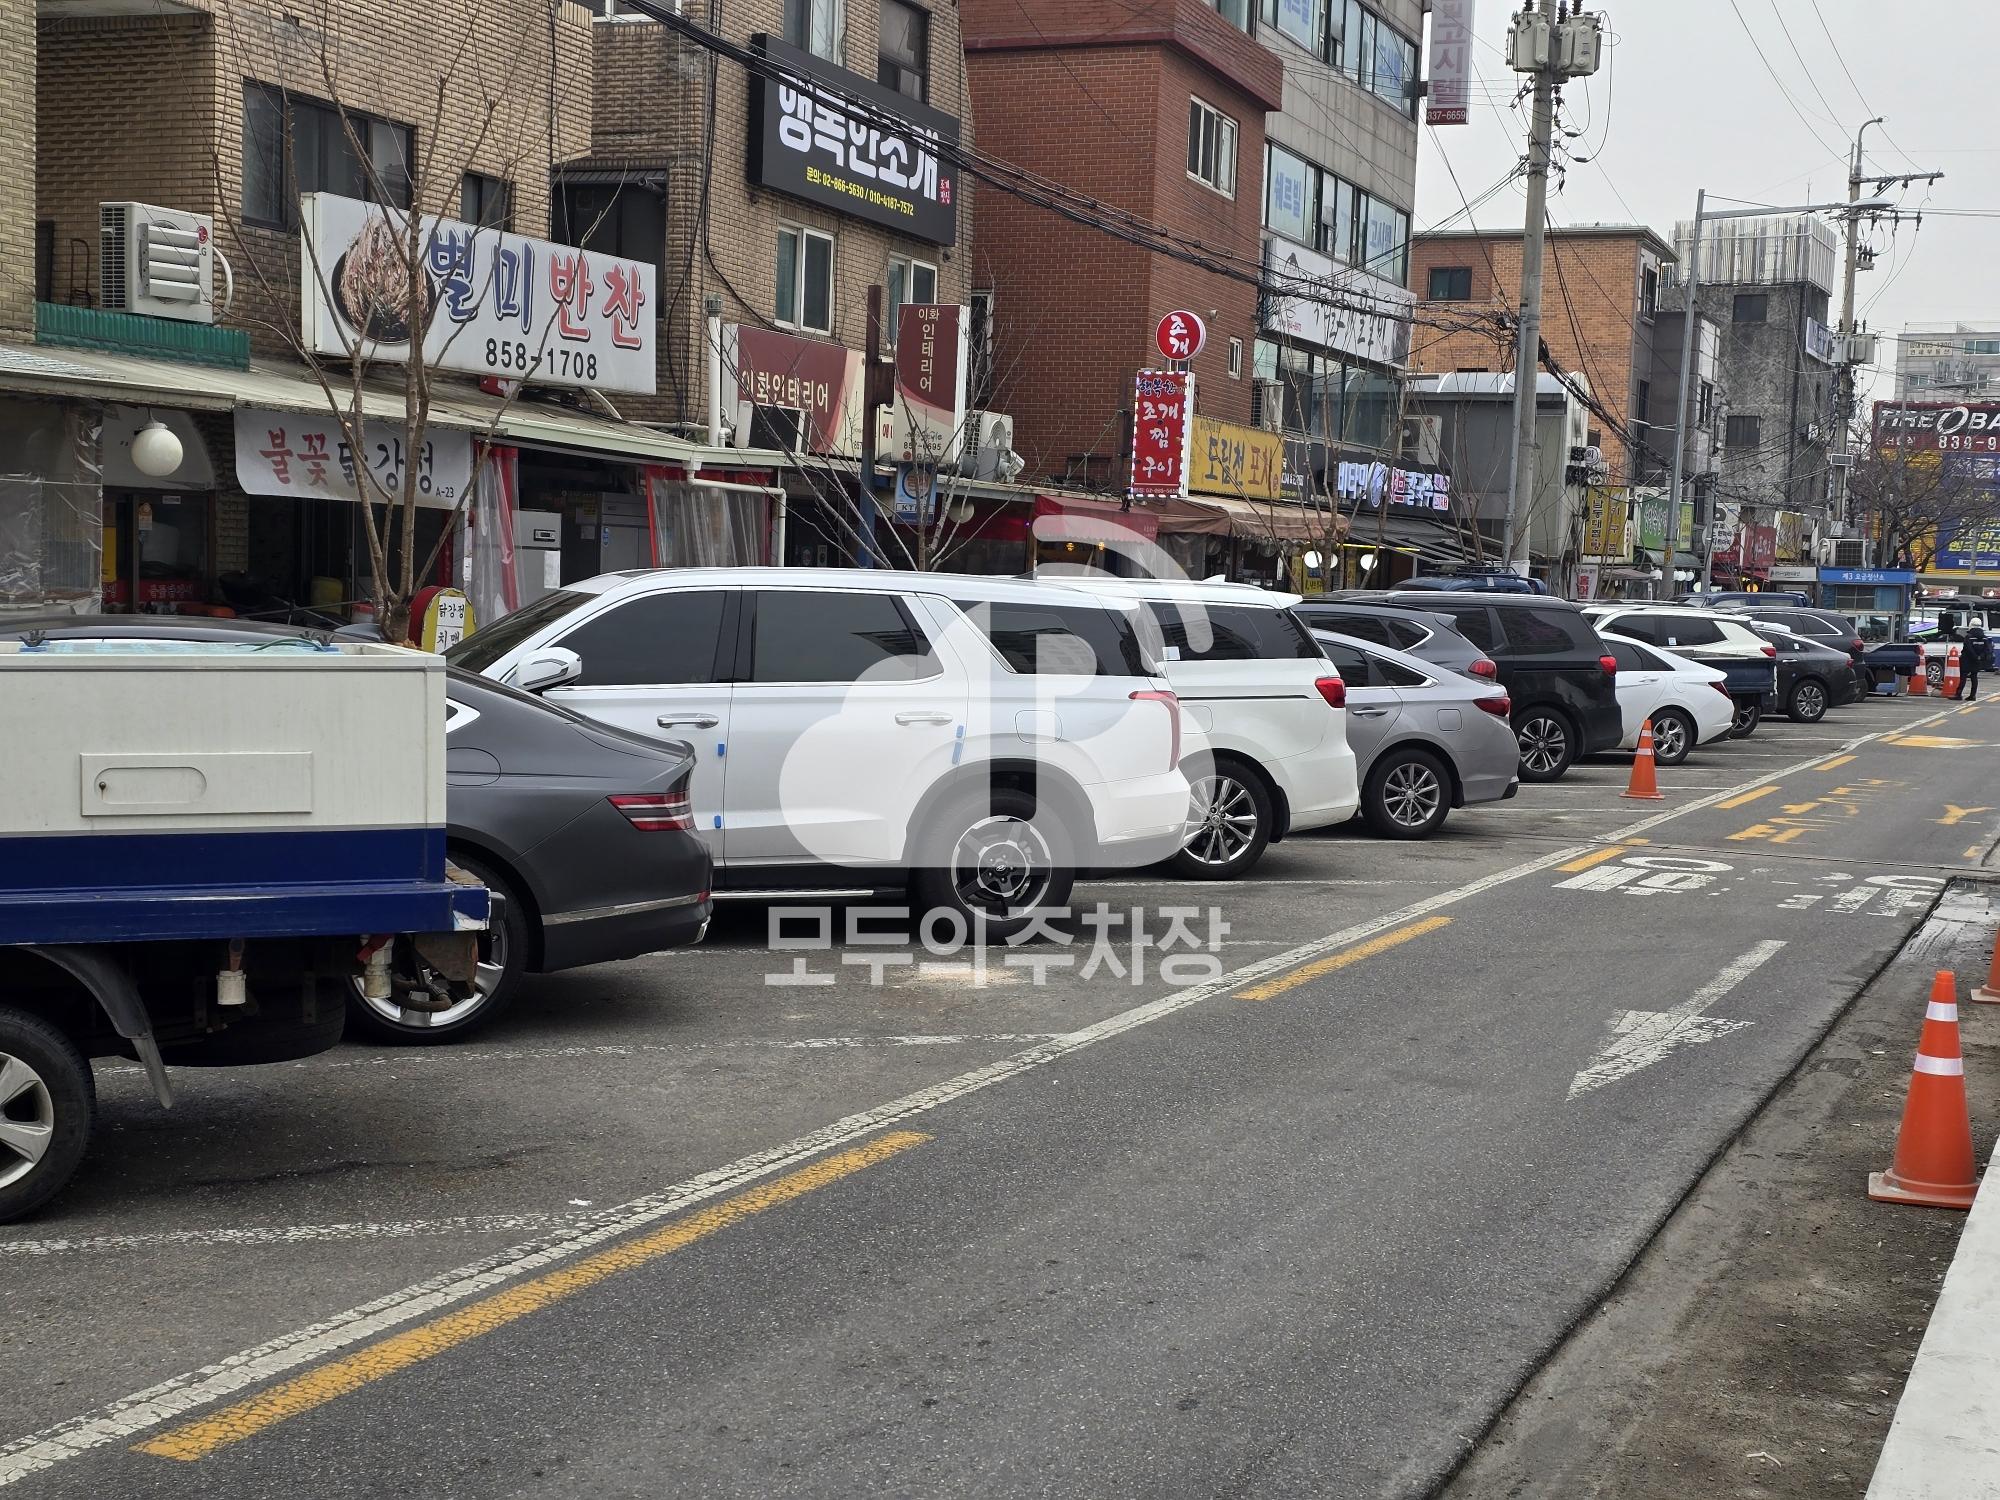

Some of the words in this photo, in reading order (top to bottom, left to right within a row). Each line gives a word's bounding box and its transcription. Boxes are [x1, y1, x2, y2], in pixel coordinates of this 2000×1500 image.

[918, 307, 940, 321] 이화
[485, 337, 598, 381] 858-1708
[919, 323, 935, 393] 인테리어
[740, 369, 829, 413] 이화인테리어
[1139, 377, 1176, 398] 행복한
[1142, 401, 1179, 420] 조개
[1149, 426, 1169, 449] 찜
[1142, 455, 1173, 478] 구이
[435, 486, 455, 498] A-23
[438, 603, 465, 619] 닭강정
